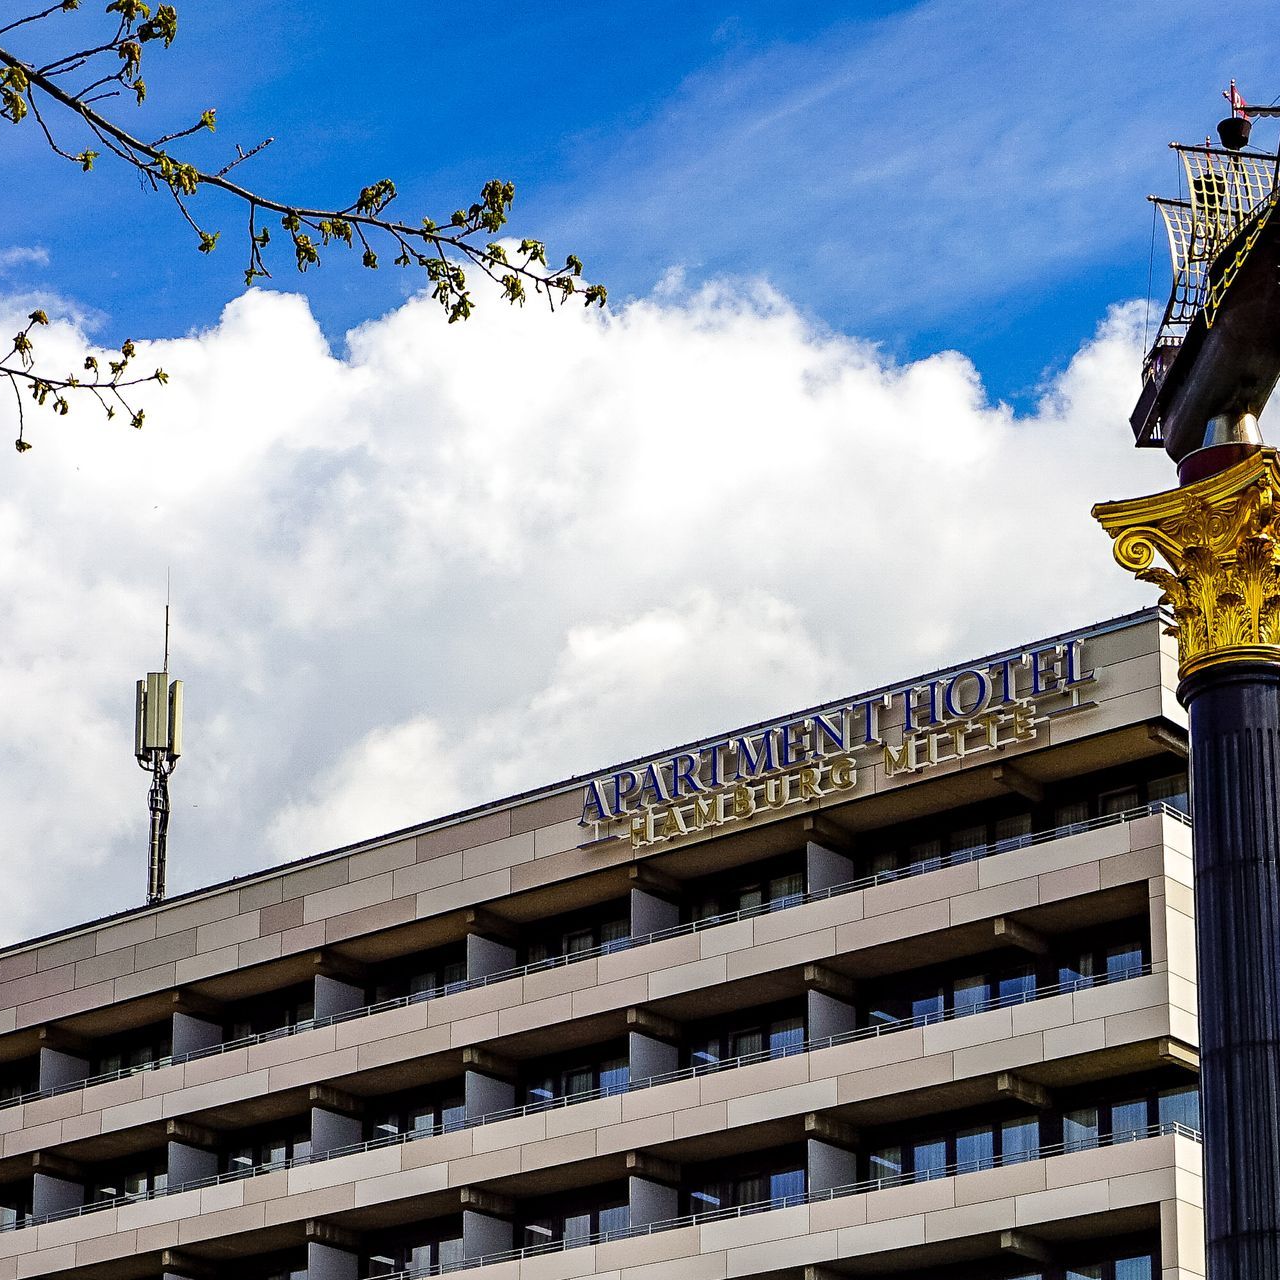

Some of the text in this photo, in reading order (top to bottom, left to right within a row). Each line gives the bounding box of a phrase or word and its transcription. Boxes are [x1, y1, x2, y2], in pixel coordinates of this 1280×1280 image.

[577, 638, 1100, 827] APARTMENT HOTEL
[630, 701, 1037, 848] HAMBURG MITTE
